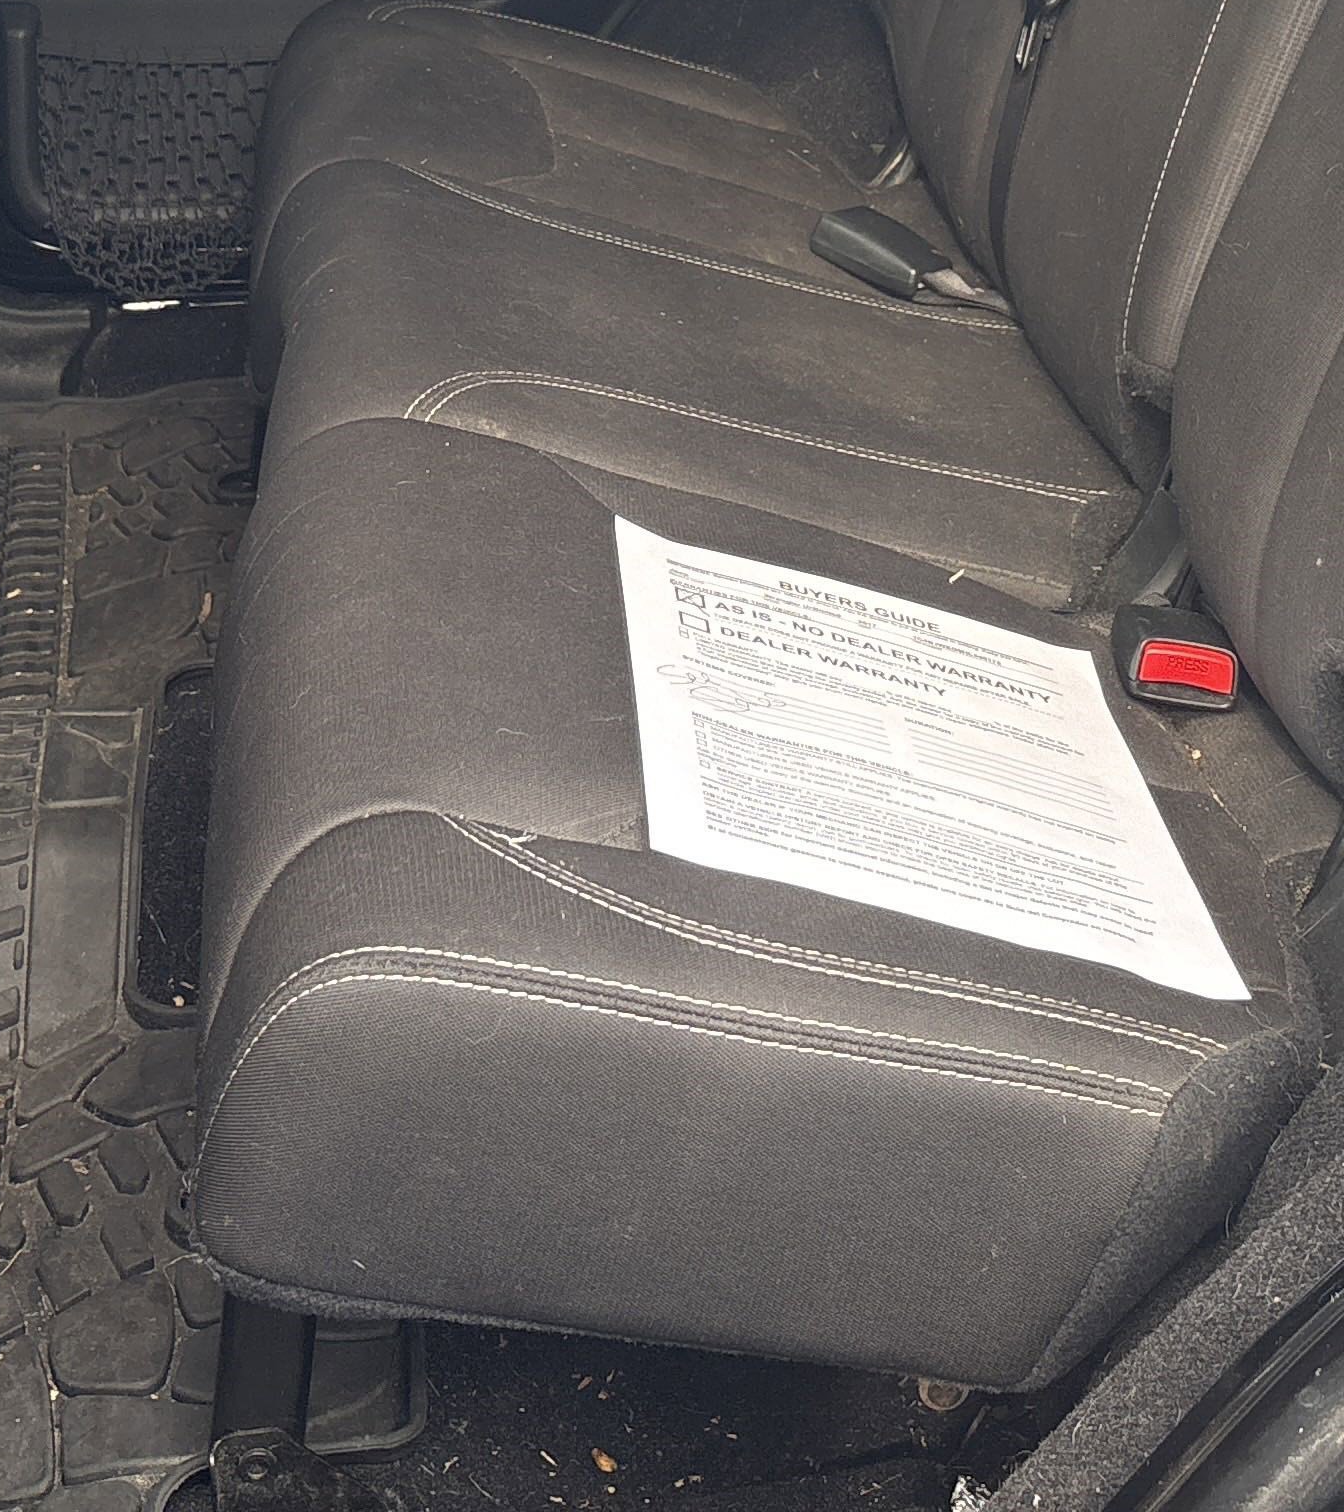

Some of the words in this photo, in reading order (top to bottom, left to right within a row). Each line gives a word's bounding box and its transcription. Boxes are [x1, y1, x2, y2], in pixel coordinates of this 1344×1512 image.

[779, 581, 867, 611] BUYERS
[873, 607, 941, 633] GUIDE
[714, 601, 744, 615] AS
[752, 611, 771, 622] IS
[792, 622, 824, 637] NO
[831, 633, 921, 665] DEALER
[927, 661, 1049, 703] WARRANTY
[720, 627, 811, 658] DEALER
[818, 654, 947, 697] WARRANTY
[1166, 655, 1209, 674] PRESS
